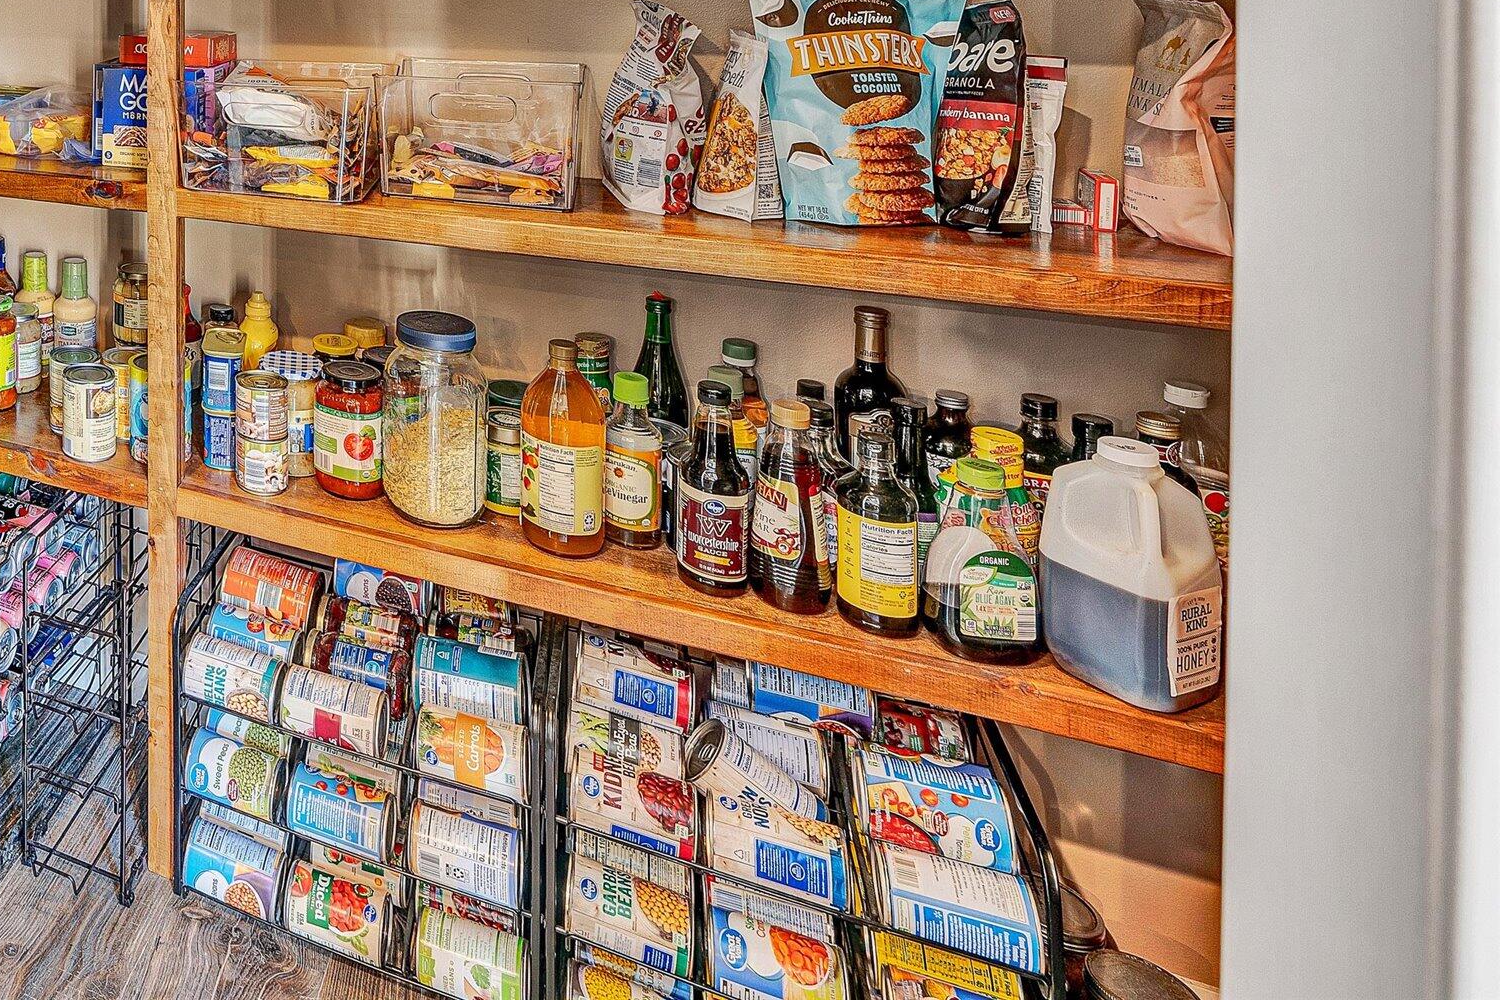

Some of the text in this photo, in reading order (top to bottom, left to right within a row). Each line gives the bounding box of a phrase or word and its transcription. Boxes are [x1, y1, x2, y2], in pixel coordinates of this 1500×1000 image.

[828, 10, 893, 28] CookieThins
[794, 32, 924, 72] THINSTERS
[949, 32, 1017, 74] bare
[851, 72, 898, 83] TOASTED
[945, 76, 995, 90] GRANOLA
[853, 82, 902, 94] COCONUT
[963, 110, 1010, 123] banana
[560, 447, 574, 456] Facts
[1024, 479, 1051, 490] BRA
[696, 514, 732, 537] W
[862, 523, 913, 536] Nutrition Facts
[688, 530, 739, 552] Worcestershire
[862, 541, 889, 554] Calories
[698, 545, 728, 557] SAUCE
[980, 555, 1009, 567] ORGANIC
[986, 586, 1006, 596] Raw
[975, 594, 1017, 607] BLUE AGAVE
[1181, 603, 1213, 622] RURAL
[1186, 616, 1209, 633] KING
[1177, 639, 1209, 655] 100% PURE
[1176, 648, 1210, 674] HONEY
[466, 724, 482, 771] Carrots
[624, 732, 638, 761] Peas
[213, 742, 231, 791] Sweet Peas
[194, 767, 204, 788] Great
[602, 756, 623, 810] KIDN
[314, 873, 332, 920] Diced
[602, 868, 617, 917] GARBA
[724, 934, 739, 965] Great
